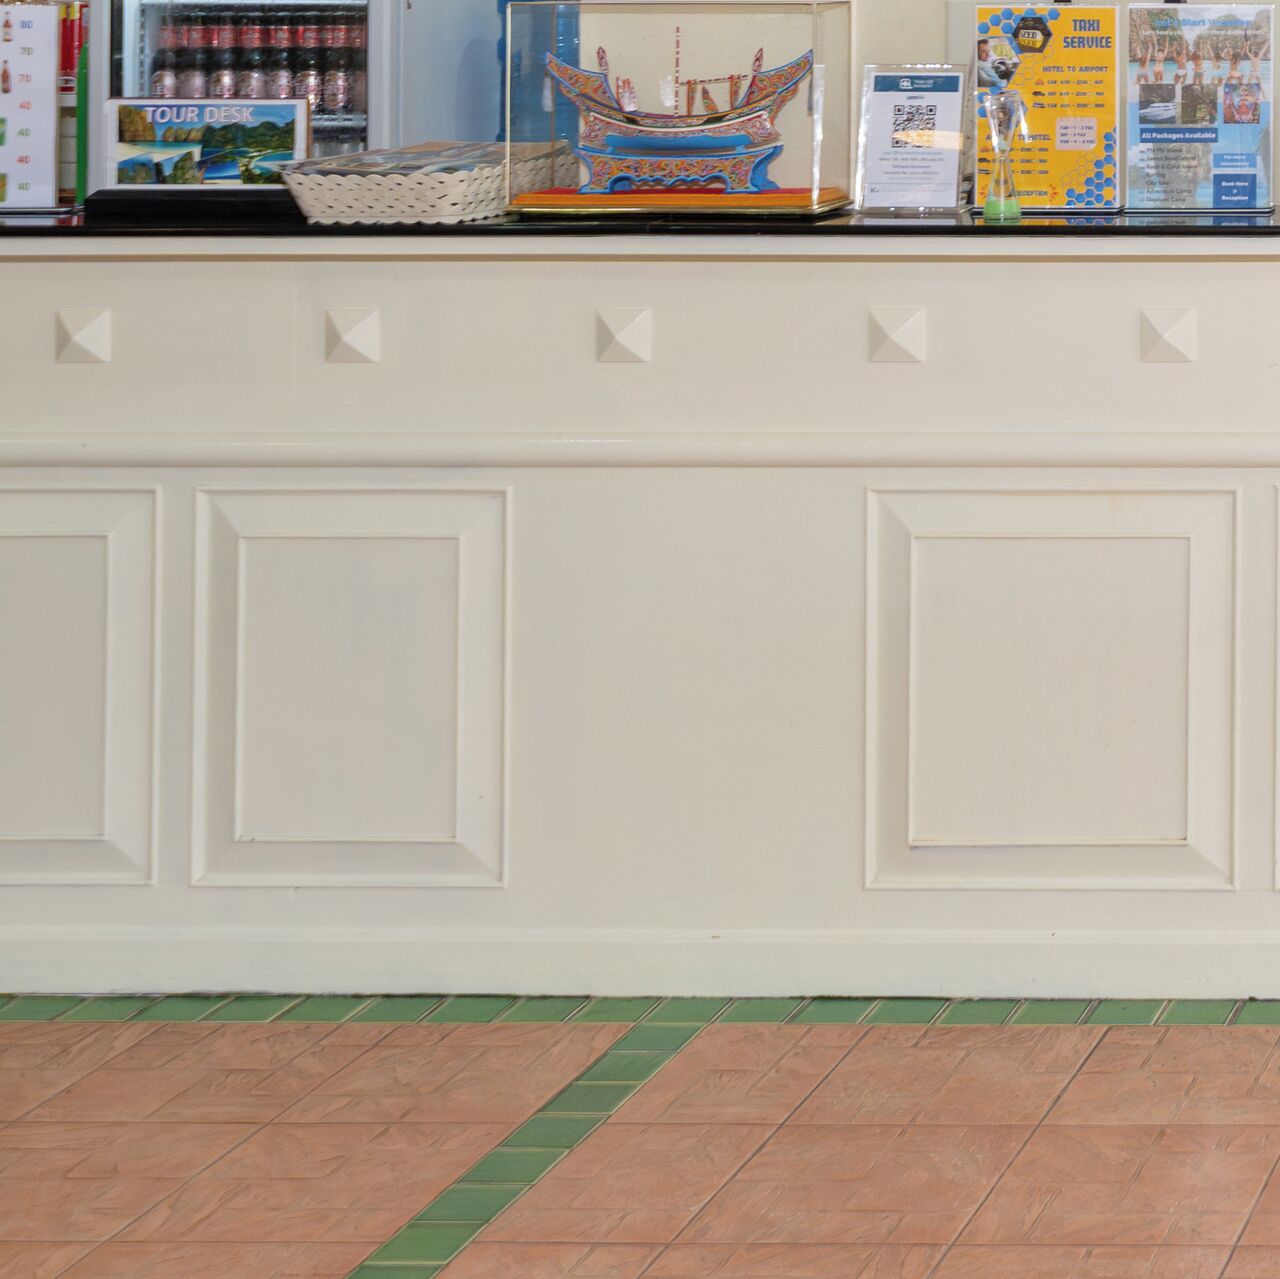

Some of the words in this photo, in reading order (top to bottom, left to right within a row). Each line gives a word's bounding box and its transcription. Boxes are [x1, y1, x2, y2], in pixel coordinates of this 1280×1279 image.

[1072, 19, 1101, 32] TAXI
[1063, 36, 1112, 48] SERVICE
[144, 106, 199, 124] TOUR
[204, 106, 255, 123] DESK
[1152, 132, 1183, 140] Packages
